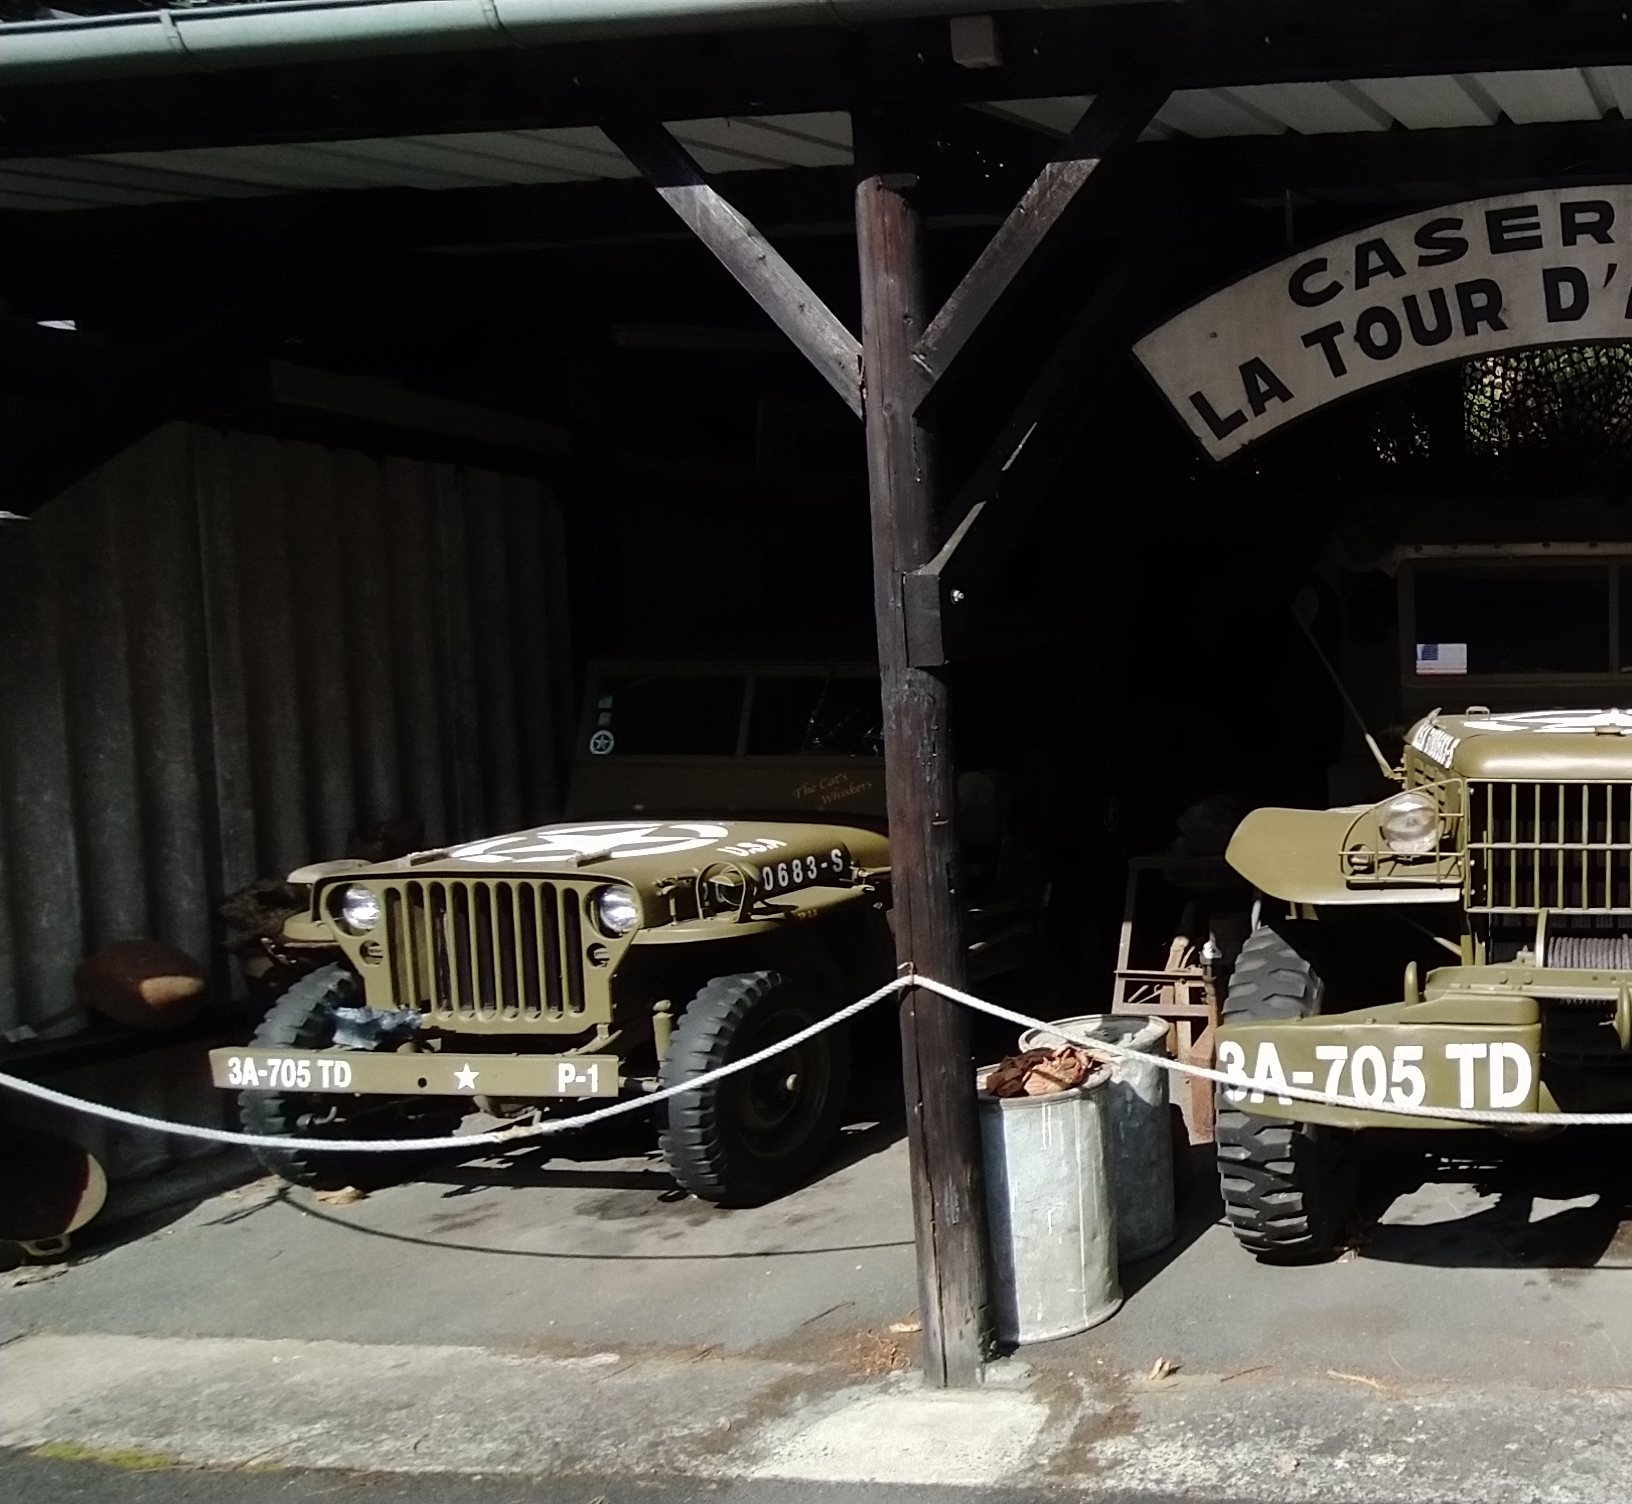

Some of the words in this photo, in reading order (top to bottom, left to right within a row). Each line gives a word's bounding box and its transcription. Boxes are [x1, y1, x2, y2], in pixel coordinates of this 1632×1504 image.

[1189, 358, 1294, 441] LA
[1301, 278, 1508, 380] TOUR
[228, 1056, 311, 1088] 3A-705
[318, 1060, 352, 1088] TD
[558, 1063, 599, 1092] P-1
[1446, 1043, 1532, 1110] TD
